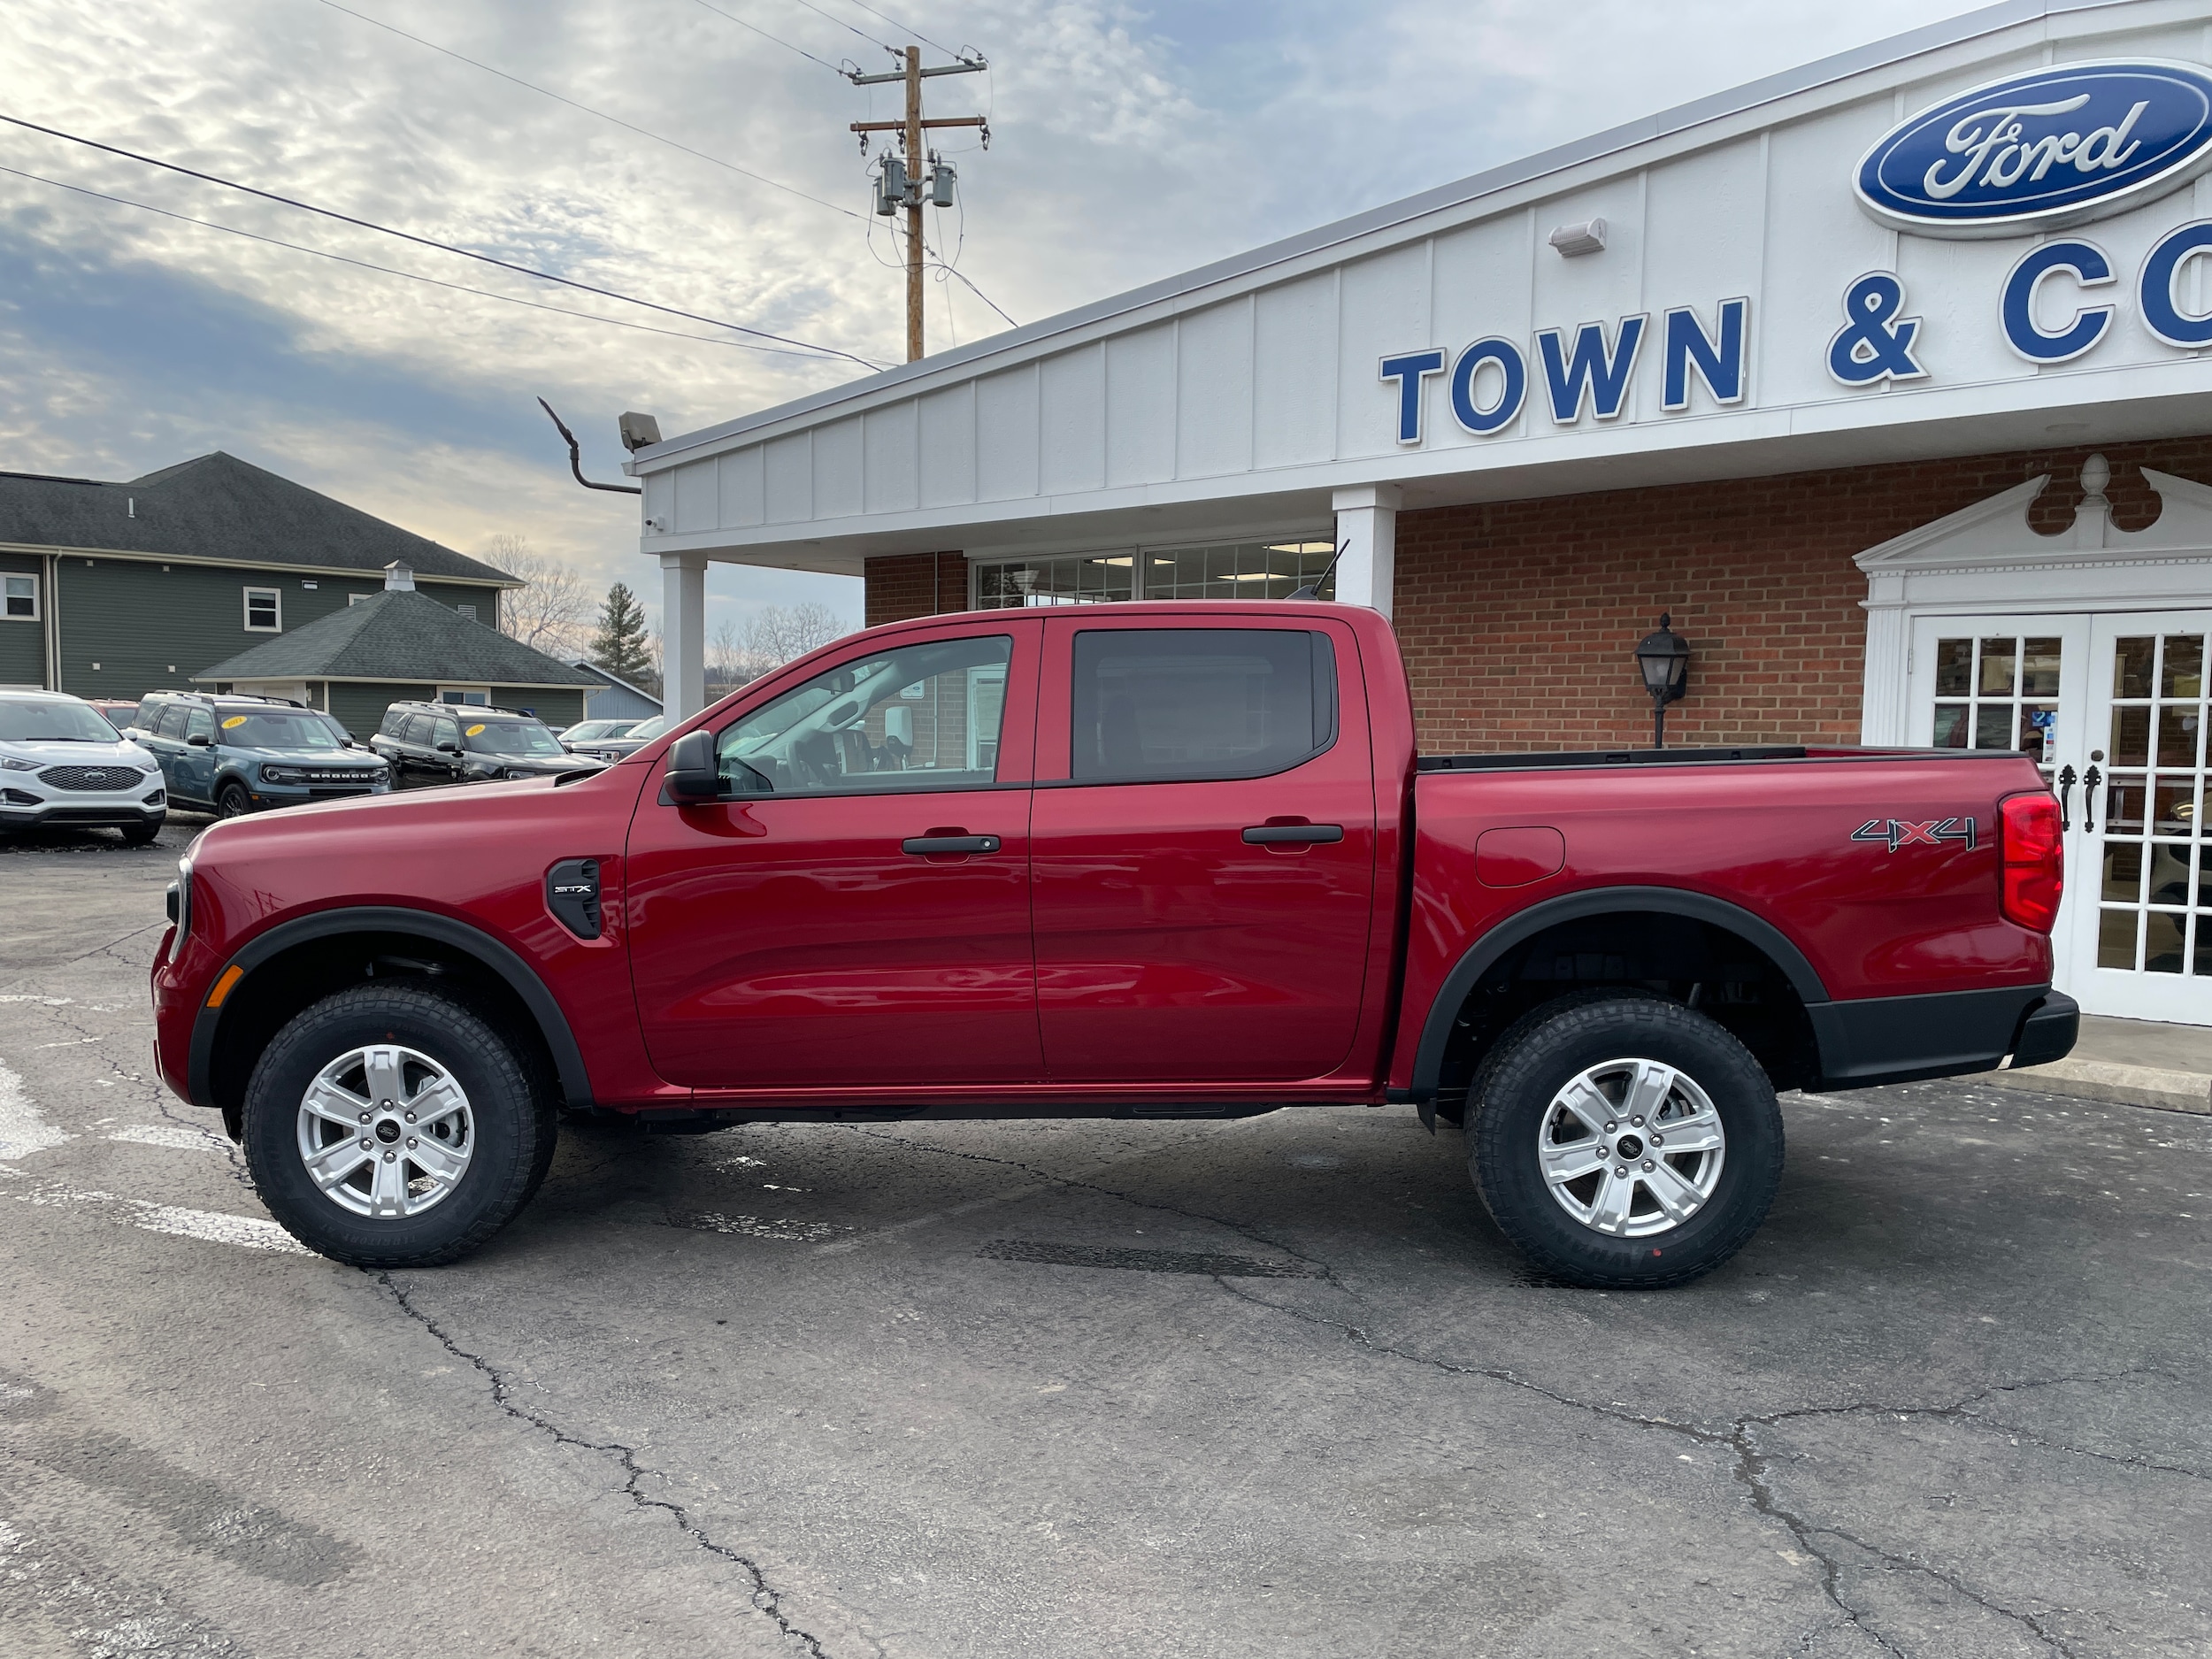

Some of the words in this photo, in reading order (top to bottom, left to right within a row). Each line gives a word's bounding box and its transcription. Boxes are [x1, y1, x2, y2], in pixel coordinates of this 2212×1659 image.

[1923, 93, 2150, 200] Ford
[1379, 296, 1749, 445] TOWN
[1824, 270, 1931, 387] &
